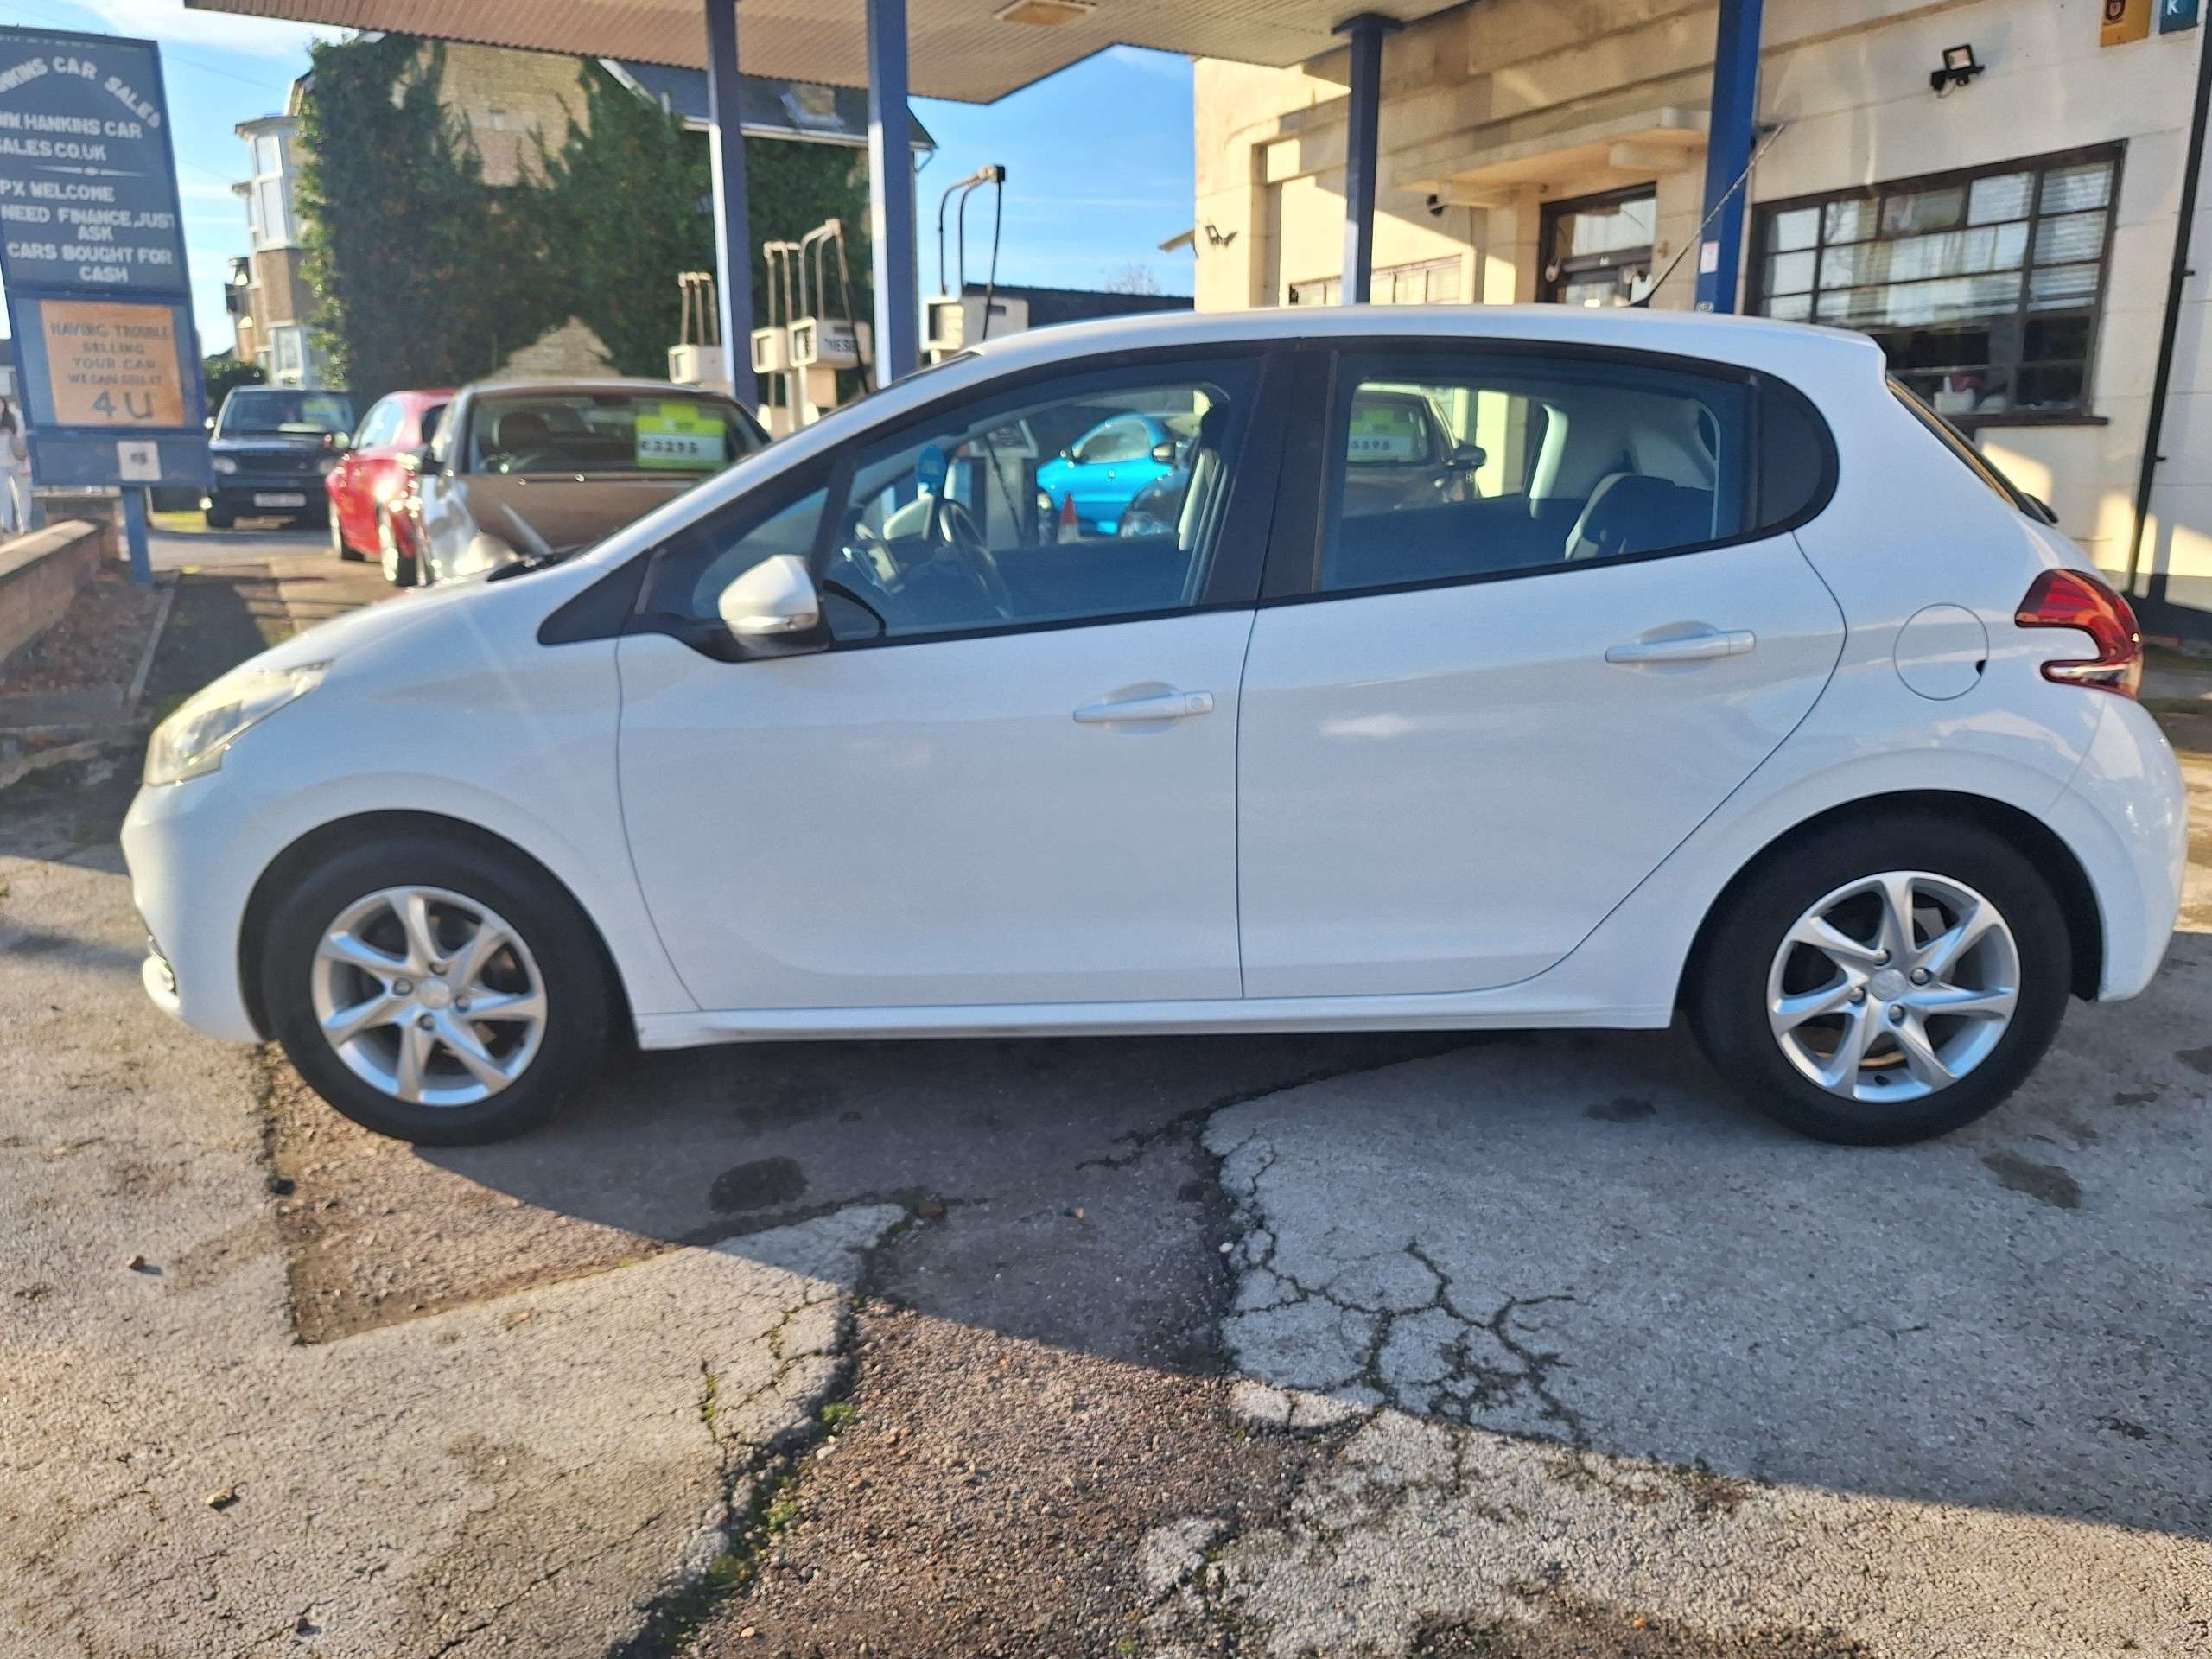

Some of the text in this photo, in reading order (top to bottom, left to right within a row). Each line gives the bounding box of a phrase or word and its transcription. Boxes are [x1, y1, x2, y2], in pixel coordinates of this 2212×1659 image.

[53, 56, 97, 80] CAR
[104, 76, 162, 128] SALES
[104, 120, 143, 139] CAR
[1, 204, 51, 223] NEED
[78, 225, 114, 242] ASK
[7, 242, 173, 264] CARS BOUGHT FOR
[79, 266, 129, 283] CASH
[72, 358, 116, 369] YOUR
[92, 391, 154, 419] 4 U
